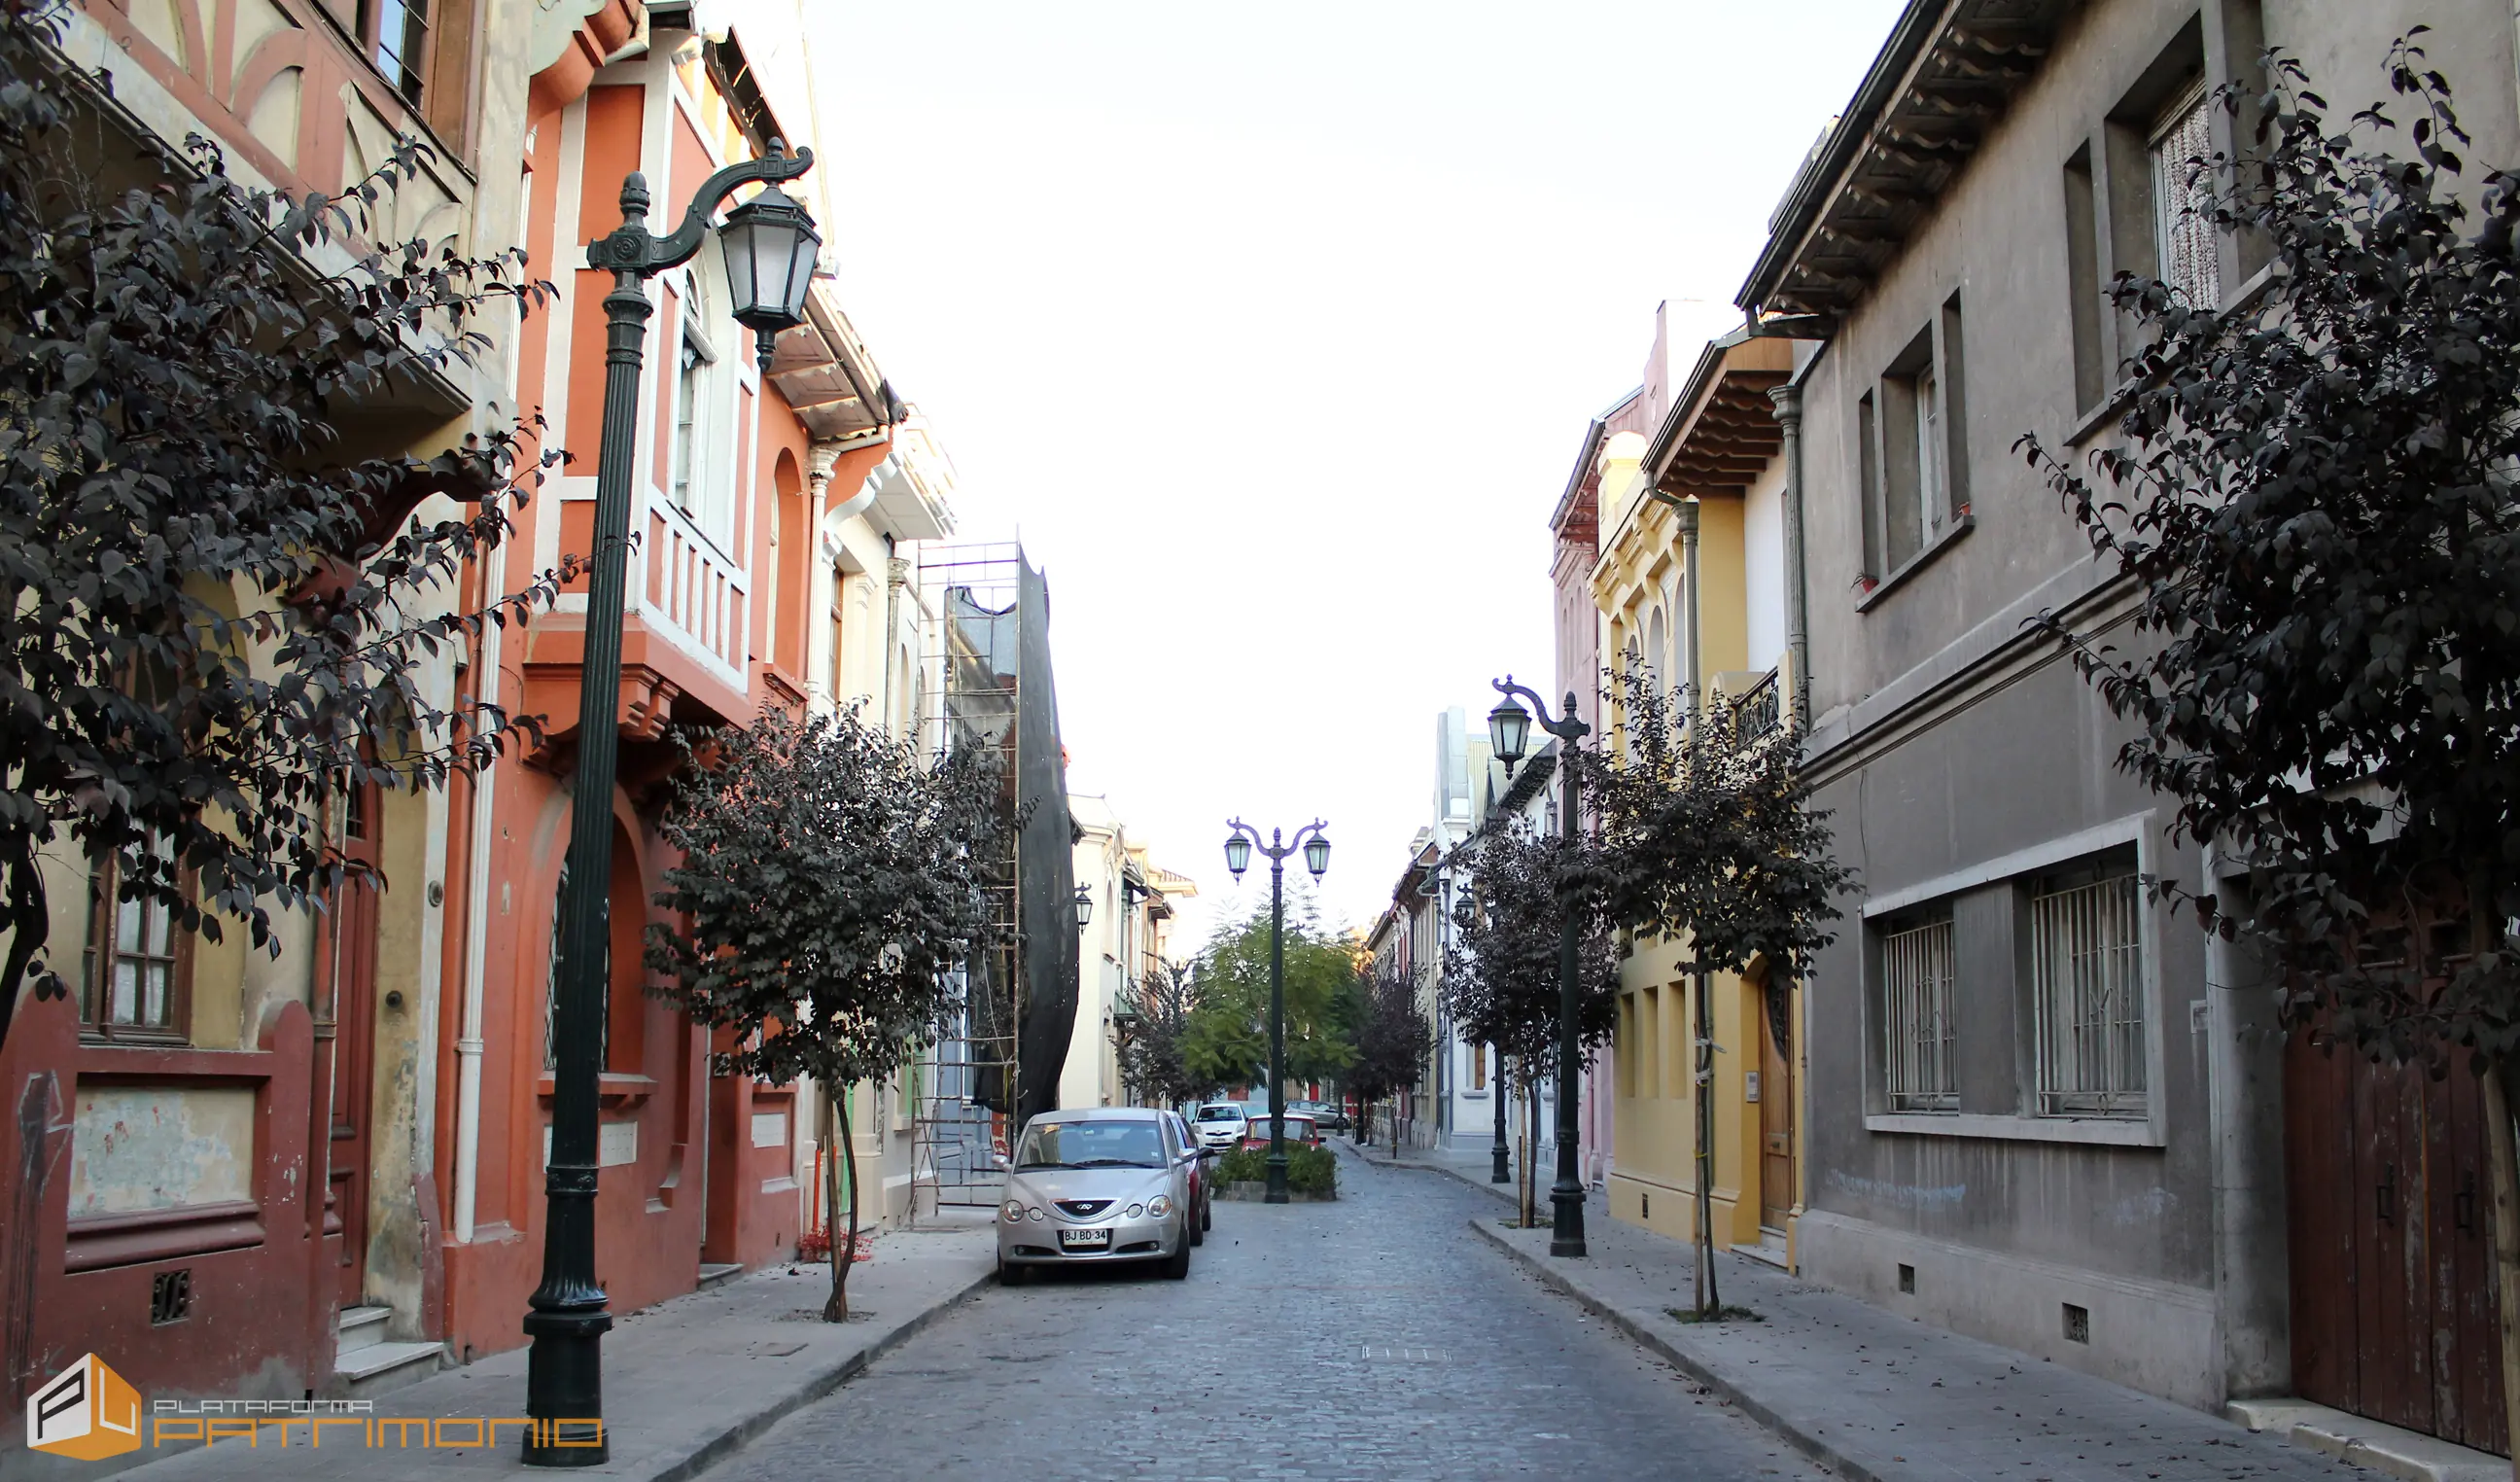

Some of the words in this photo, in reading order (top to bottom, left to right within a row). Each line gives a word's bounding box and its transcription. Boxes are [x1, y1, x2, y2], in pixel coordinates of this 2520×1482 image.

[1065, 1231, 1077, 1241] BJ
[1079, 1231, 1092, 1240] BD
[1095, 1230, 1106, 1240] 34
